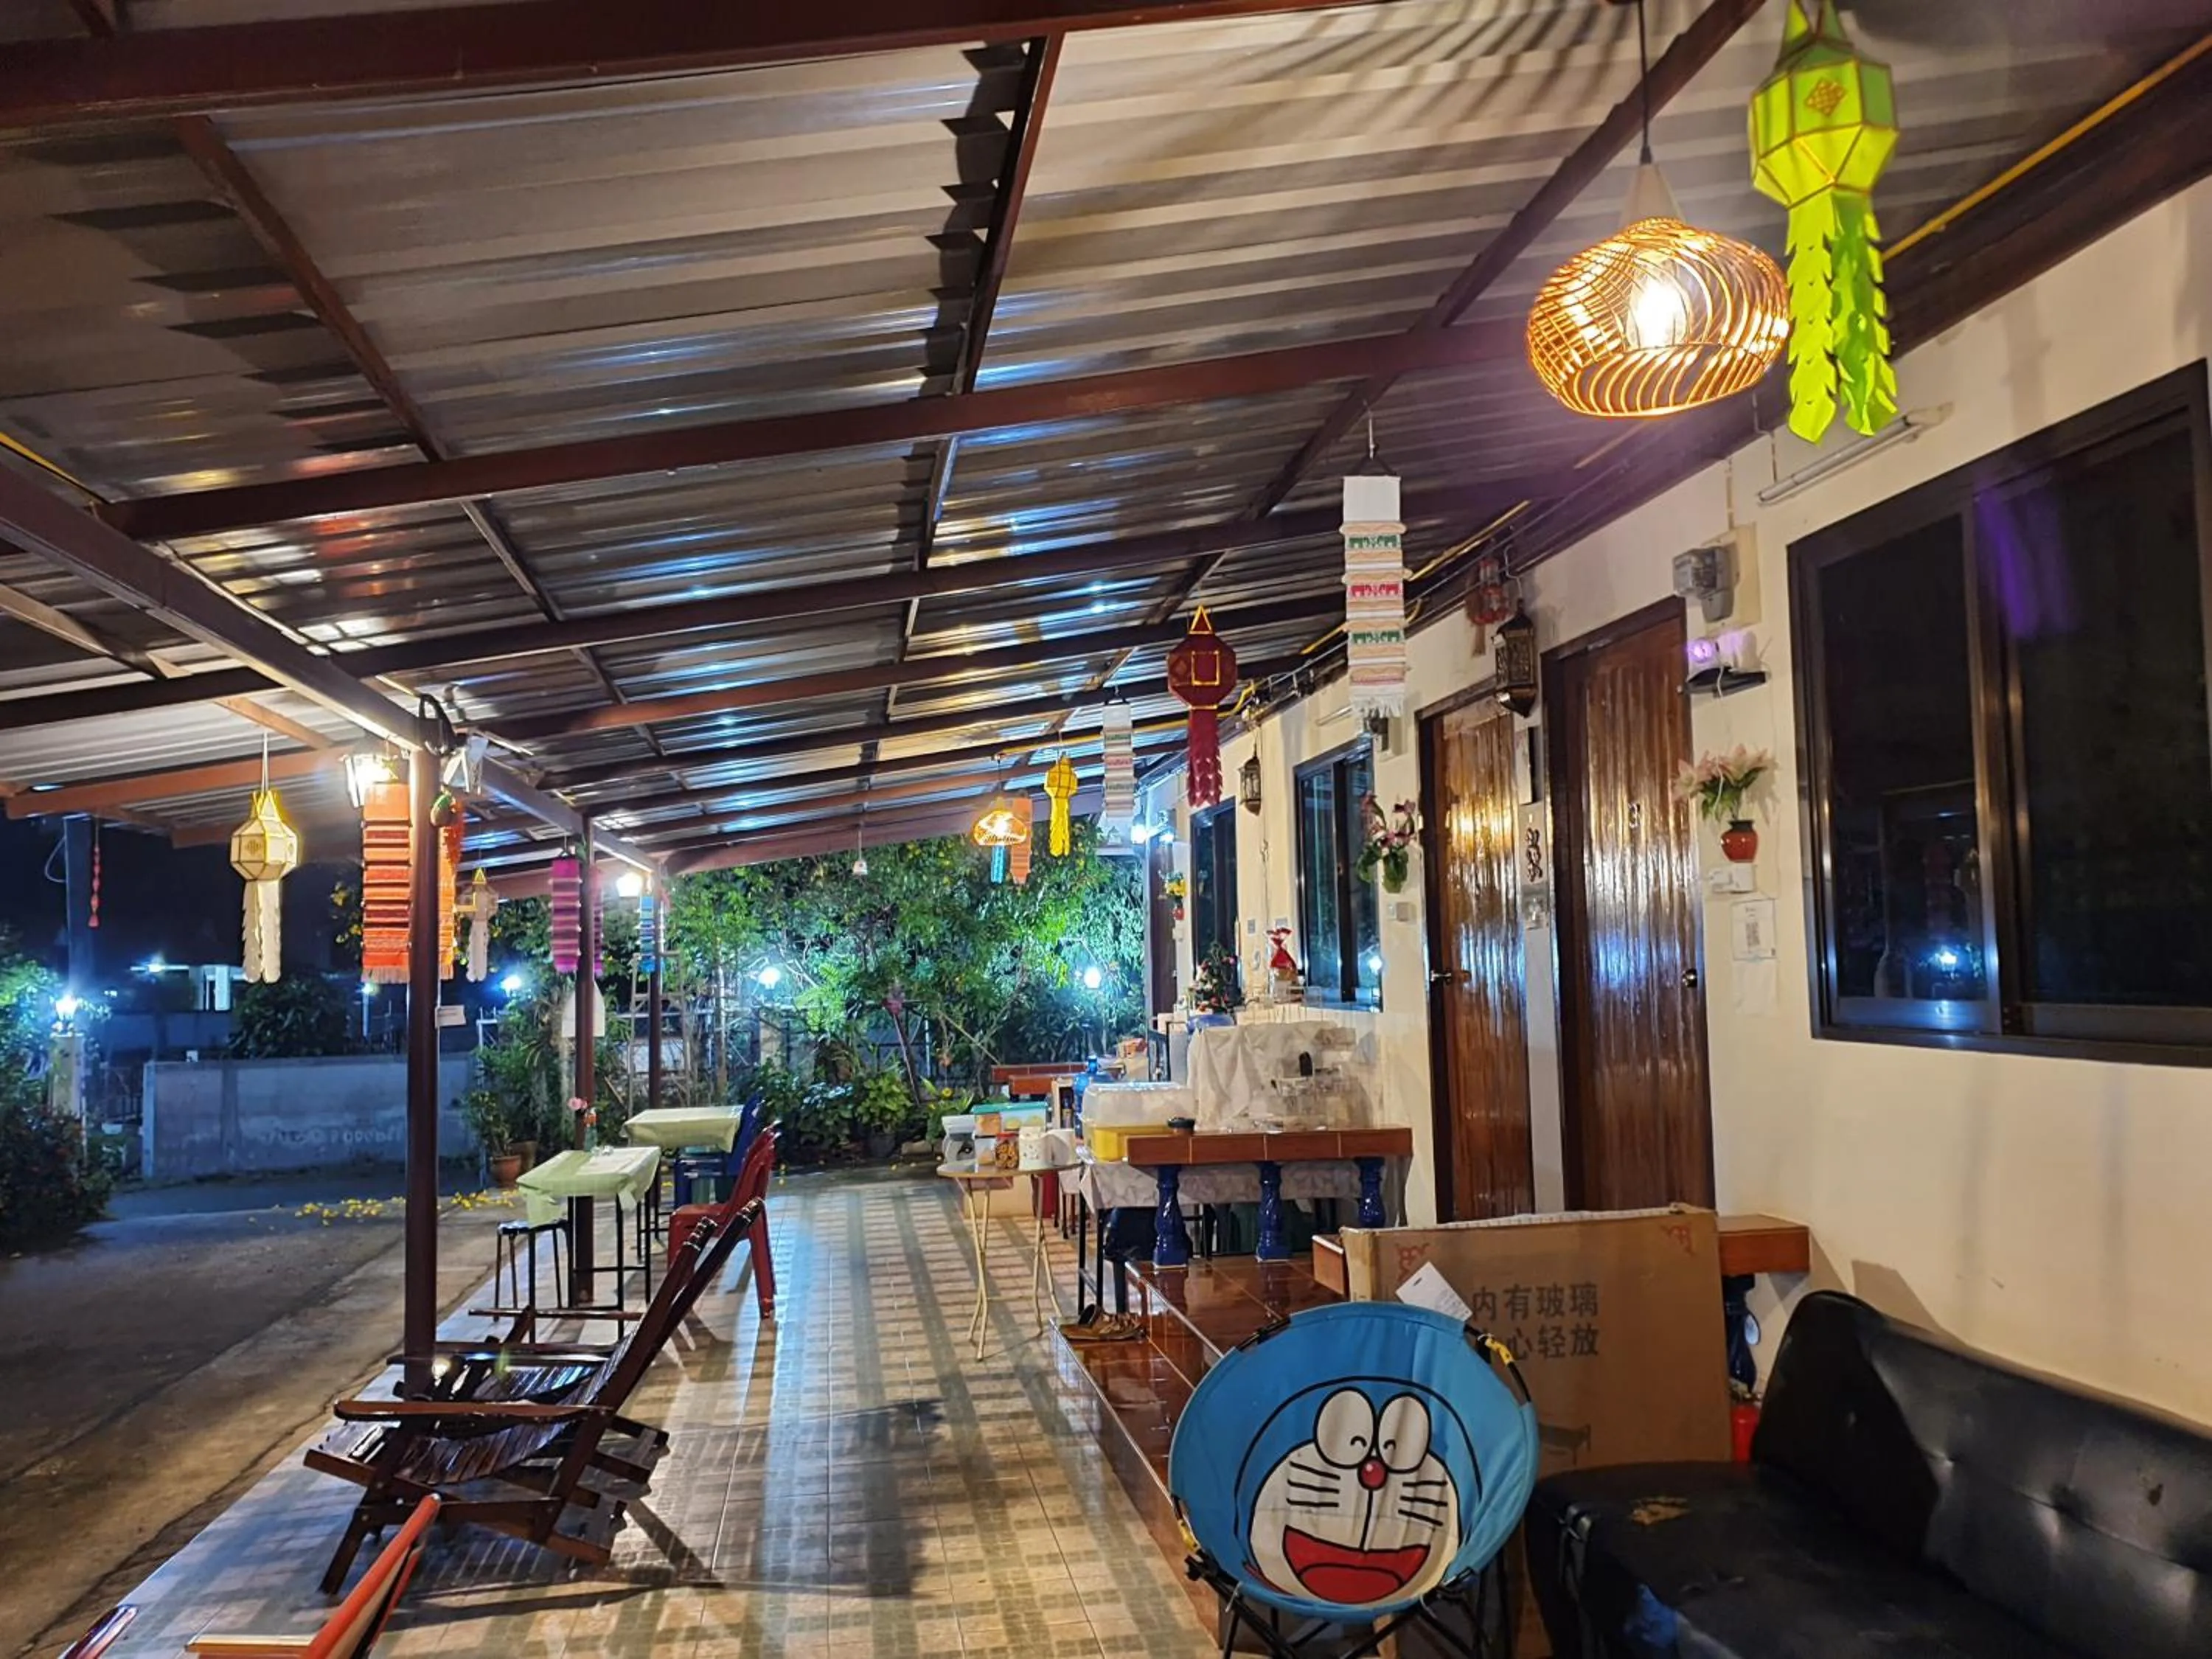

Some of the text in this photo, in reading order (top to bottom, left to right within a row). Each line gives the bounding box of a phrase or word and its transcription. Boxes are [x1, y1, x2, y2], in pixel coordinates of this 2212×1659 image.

[1472, 1281, 1599, 1321] 内有玻璃
[1482, 1324, 1599, 1360] 心轻放
